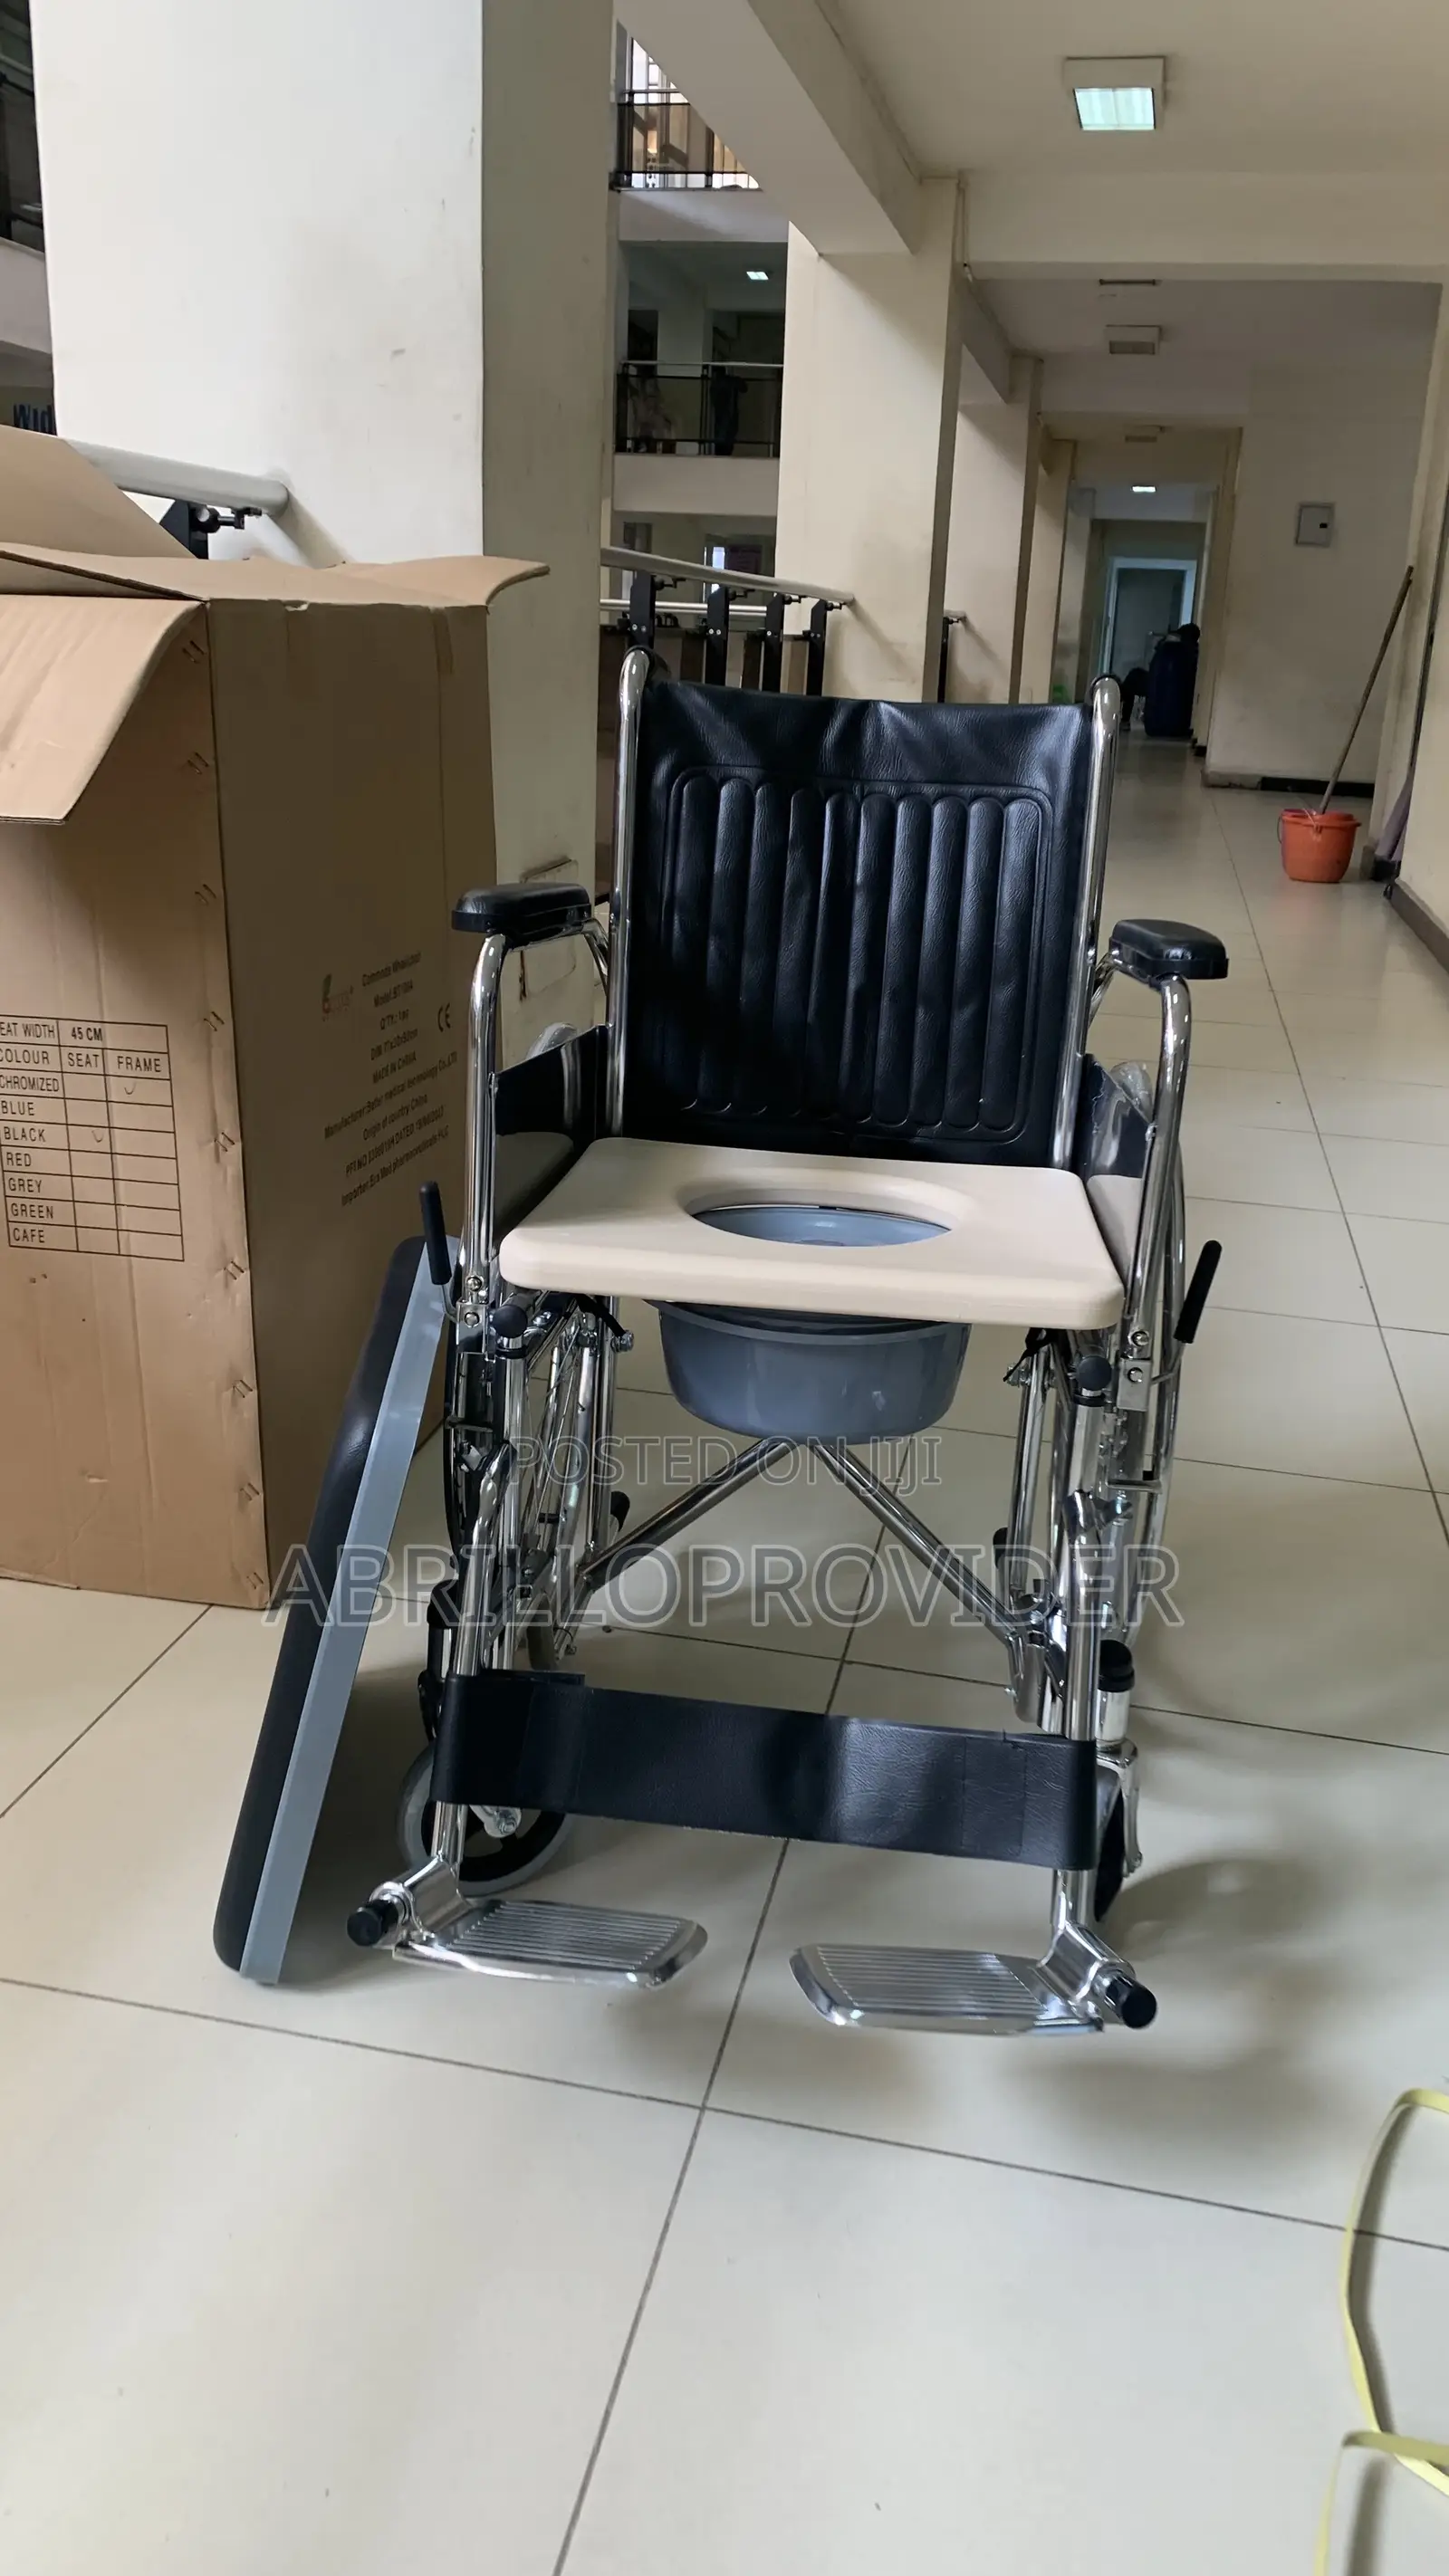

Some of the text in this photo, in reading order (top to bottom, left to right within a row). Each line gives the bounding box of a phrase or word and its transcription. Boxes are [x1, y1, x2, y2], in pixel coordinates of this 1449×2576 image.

[0, 1022, 55, 1039] EAT WIDTH
[72, 1027, 103, 1042] 45 CM
[0, 1048, 50, 1065] COLOUR
[68, 1052, 100, 1068] SEAT
[117, 1056, 162, 1073] FRAME
[372, 1062, 389, 1084] MADE
[0, 1074, 60, 1092] CHROMIZED
[1, 1100, 35, 1116] BLUE
[4, 1125, 46, 1144] BLACK
[6, 1152, 32, 1168] RED
[8, 1178, 43, 1193] GREY
[11, 1203, 54, 1221] GREEN
[13, 1229, 45, 1245] CAFE
